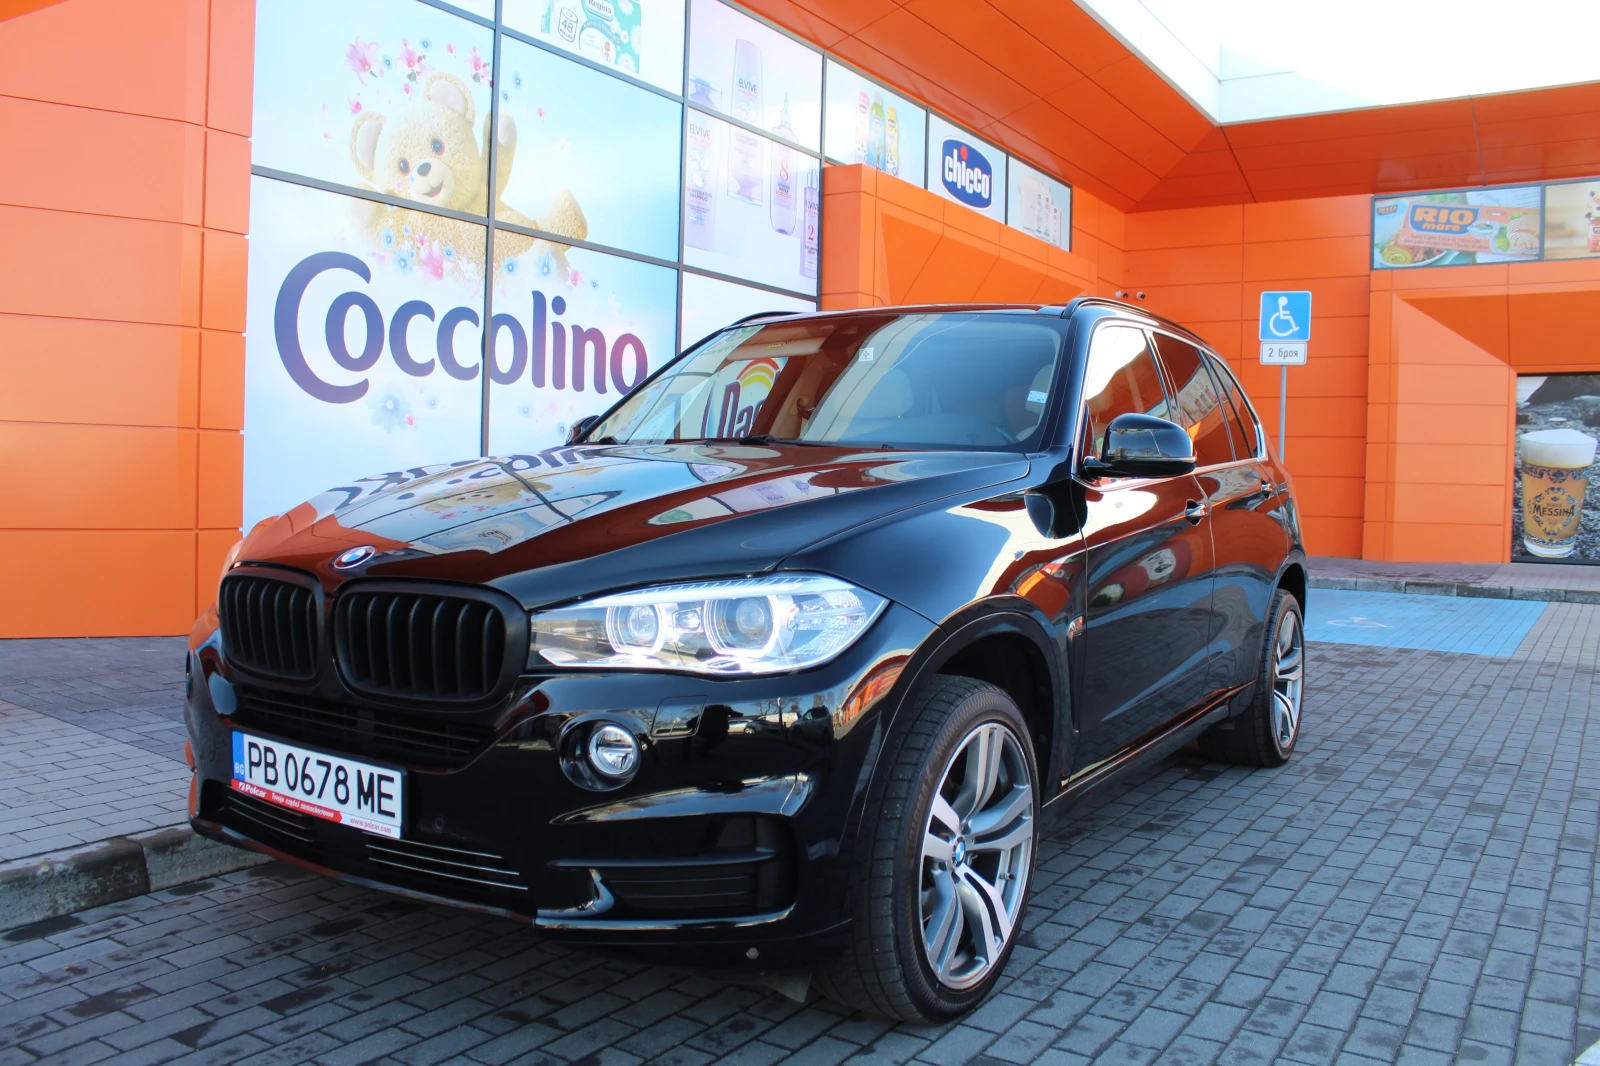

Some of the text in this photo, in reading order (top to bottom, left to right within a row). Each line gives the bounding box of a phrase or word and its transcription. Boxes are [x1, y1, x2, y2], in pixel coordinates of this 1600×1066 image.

[588, 0, 612, 15] Regina
[561, 20, 574, 34] 48
[739, 78, 757, 94] ELVIVE
[690, 124, 710, 140] ELVIVE
[780, 160, 788, 181] 8
[945, 146, 990, 199] chicco
[1414, 207, 1474, 225] RIO
[808, 225, 814, 240] 2
[1422, 222, 1460, 232] mare
[274, 251, 648, 404] Coccolino
[1268, 347, 1274, 357] 2
[1532, 502, 1576, 517] MESSINA
[234, 762, 245, 775] BG
[248, 741, 396, 819] PB 0678 ME
[244, 783, 267, 799] Polcar
